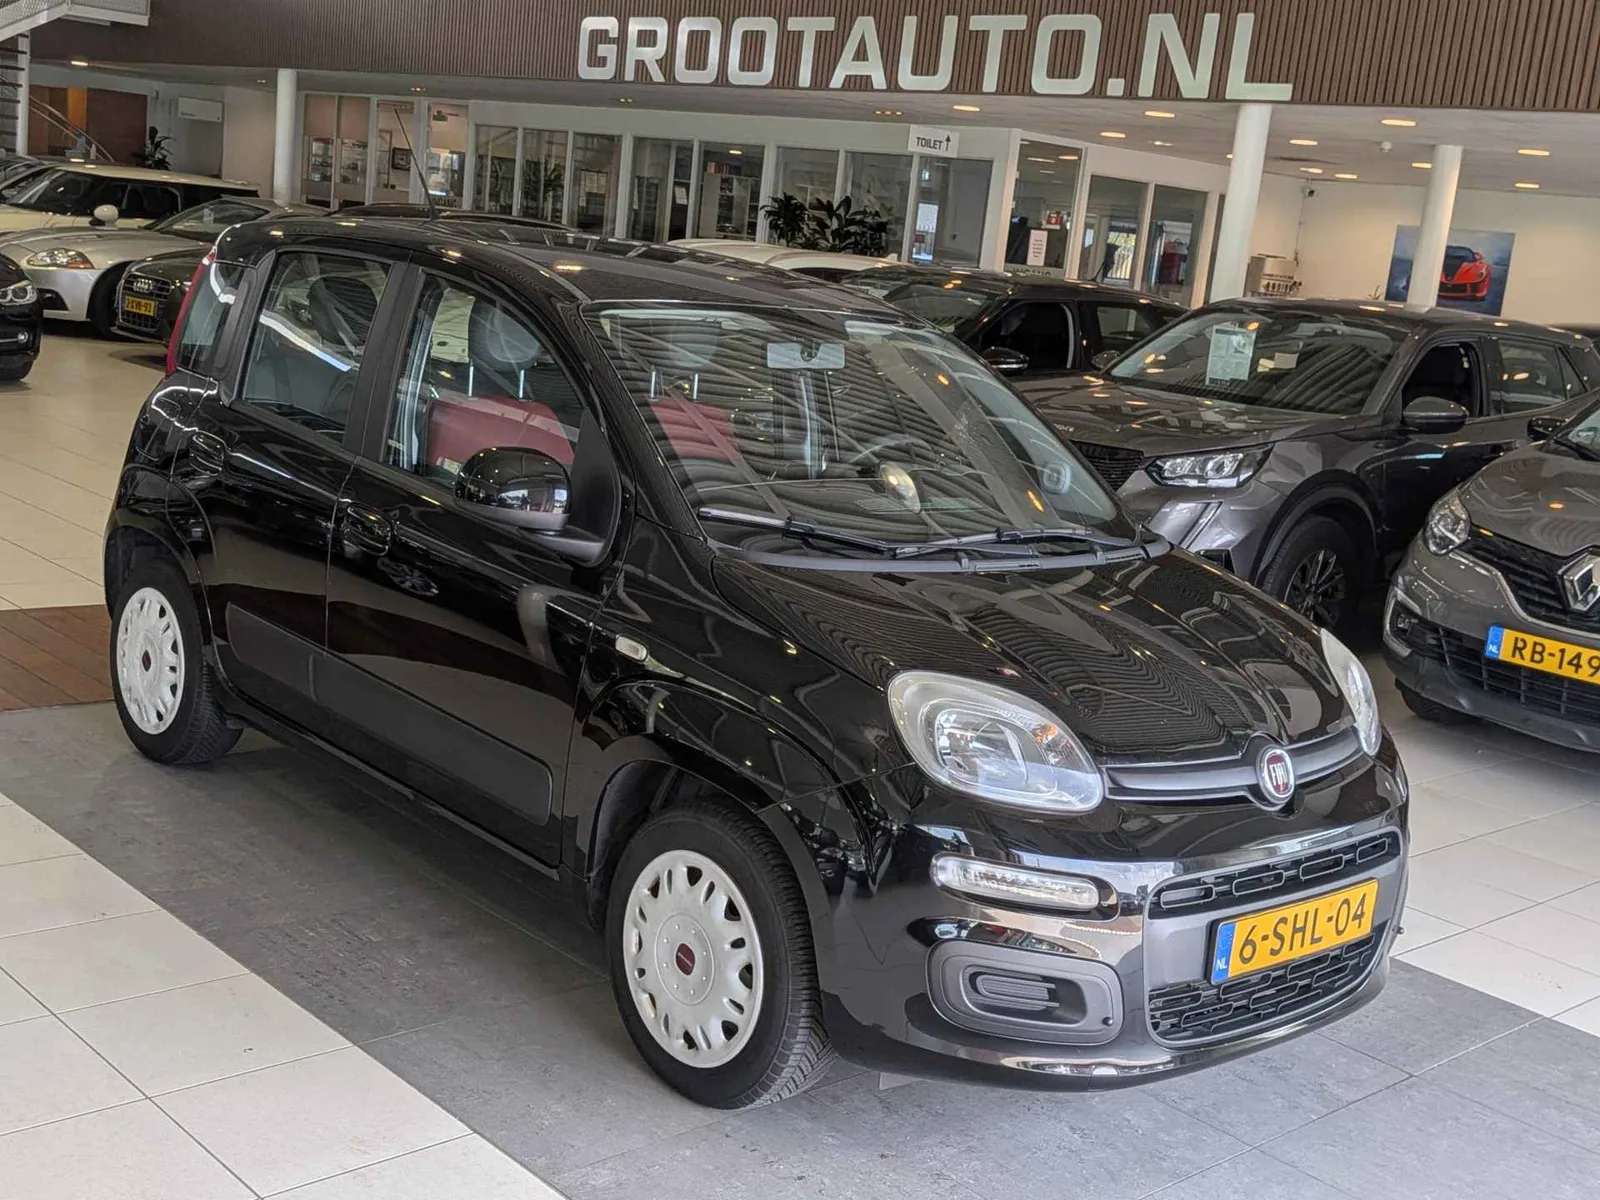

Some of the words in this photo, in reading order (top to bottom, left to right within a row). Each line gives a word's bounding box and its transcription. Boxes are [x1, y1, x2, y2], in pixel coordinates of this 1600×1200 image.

[577, 12, 1294, 102] GROOTAUTO.NL
[916, 136, 943, 150] TOILET
[1488, 644, 1499, 654] NL
[1269, 761, 1288, 787] FIAT
[1239, 892, 1367, 965] 6-SHL-04
[1215, 957, 1228, 971] NL
